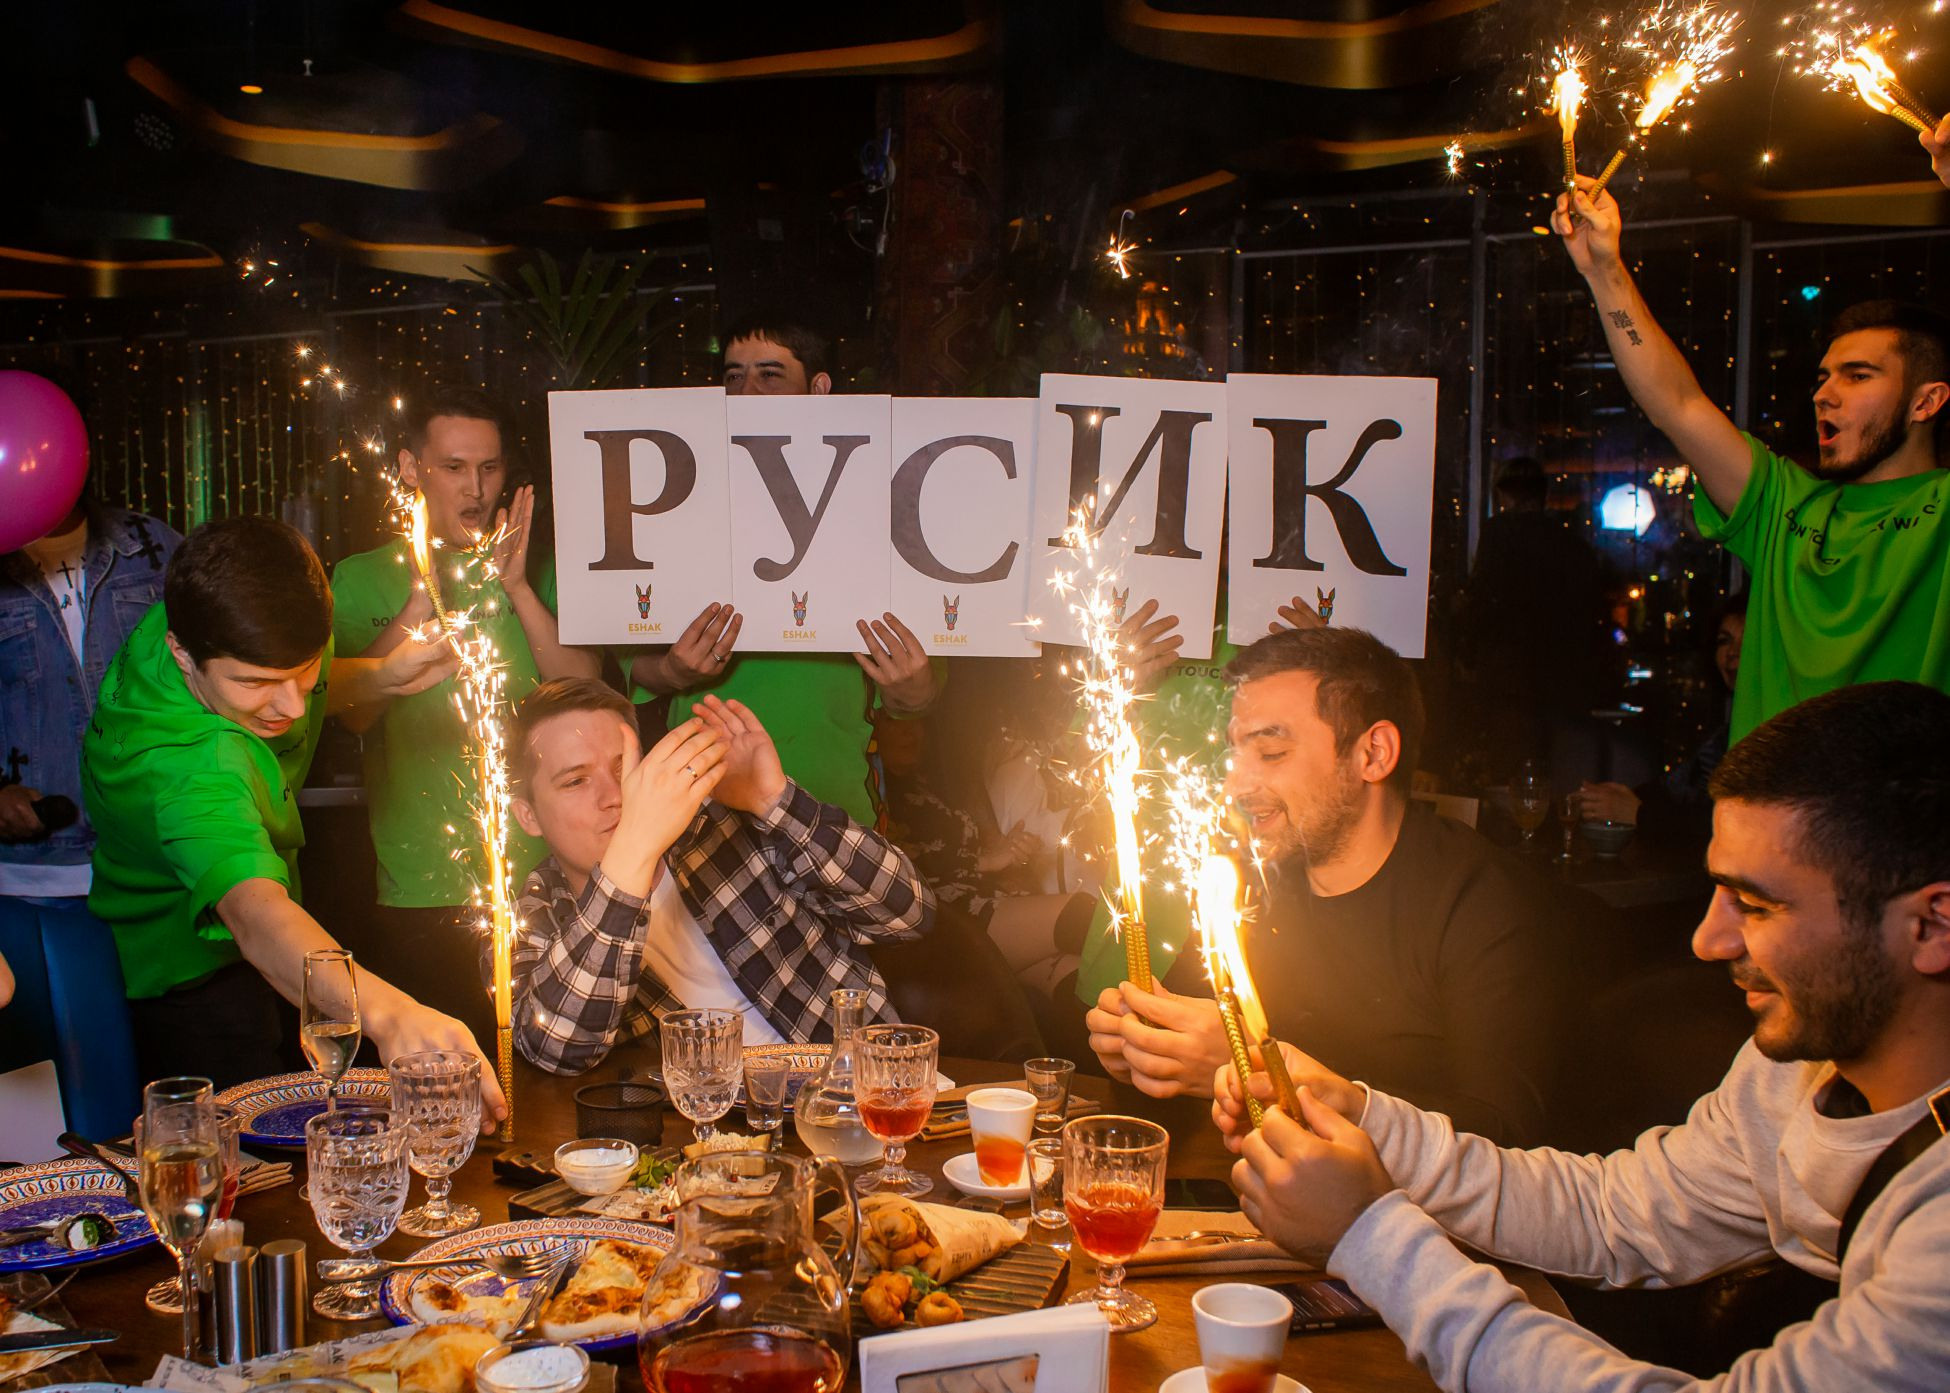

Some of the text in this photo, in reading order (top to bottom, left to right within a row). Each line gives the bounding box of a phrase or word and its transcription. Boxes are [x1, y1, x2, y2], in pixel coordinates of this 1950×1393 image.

[585, 404, 1407, 583] РУСИК
[628, 623, 662, 632] ESHAK
[783, 630, 817, 639] ESHAK
[933, 634, 968, 643] ESHAK
[1177, 665, 1222, 679] TOUC
